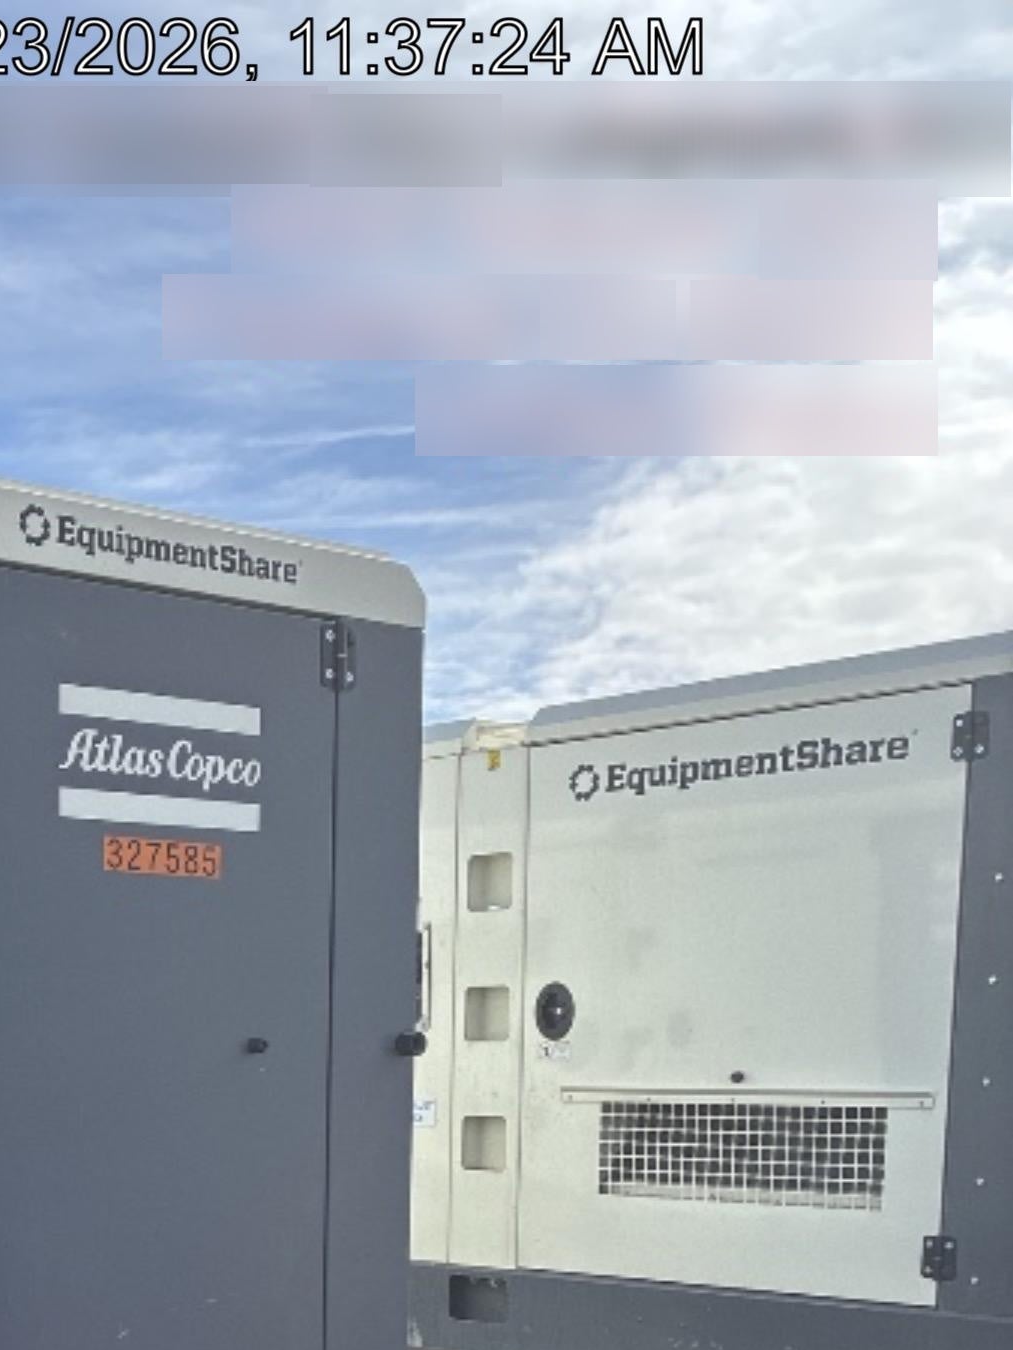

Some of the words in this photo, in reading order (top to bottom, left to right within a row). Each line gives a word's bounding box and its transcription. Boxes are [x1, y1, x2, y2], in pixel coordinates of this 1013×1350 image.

[57, 515, 298, 584] EquipmentShare
[58, 727, 165, 778] Atlas
[166, 739, 262, 792] Copco
[605, 736, 910, 796] EquipmentShare
[106, 838, 217, 877] 327585
